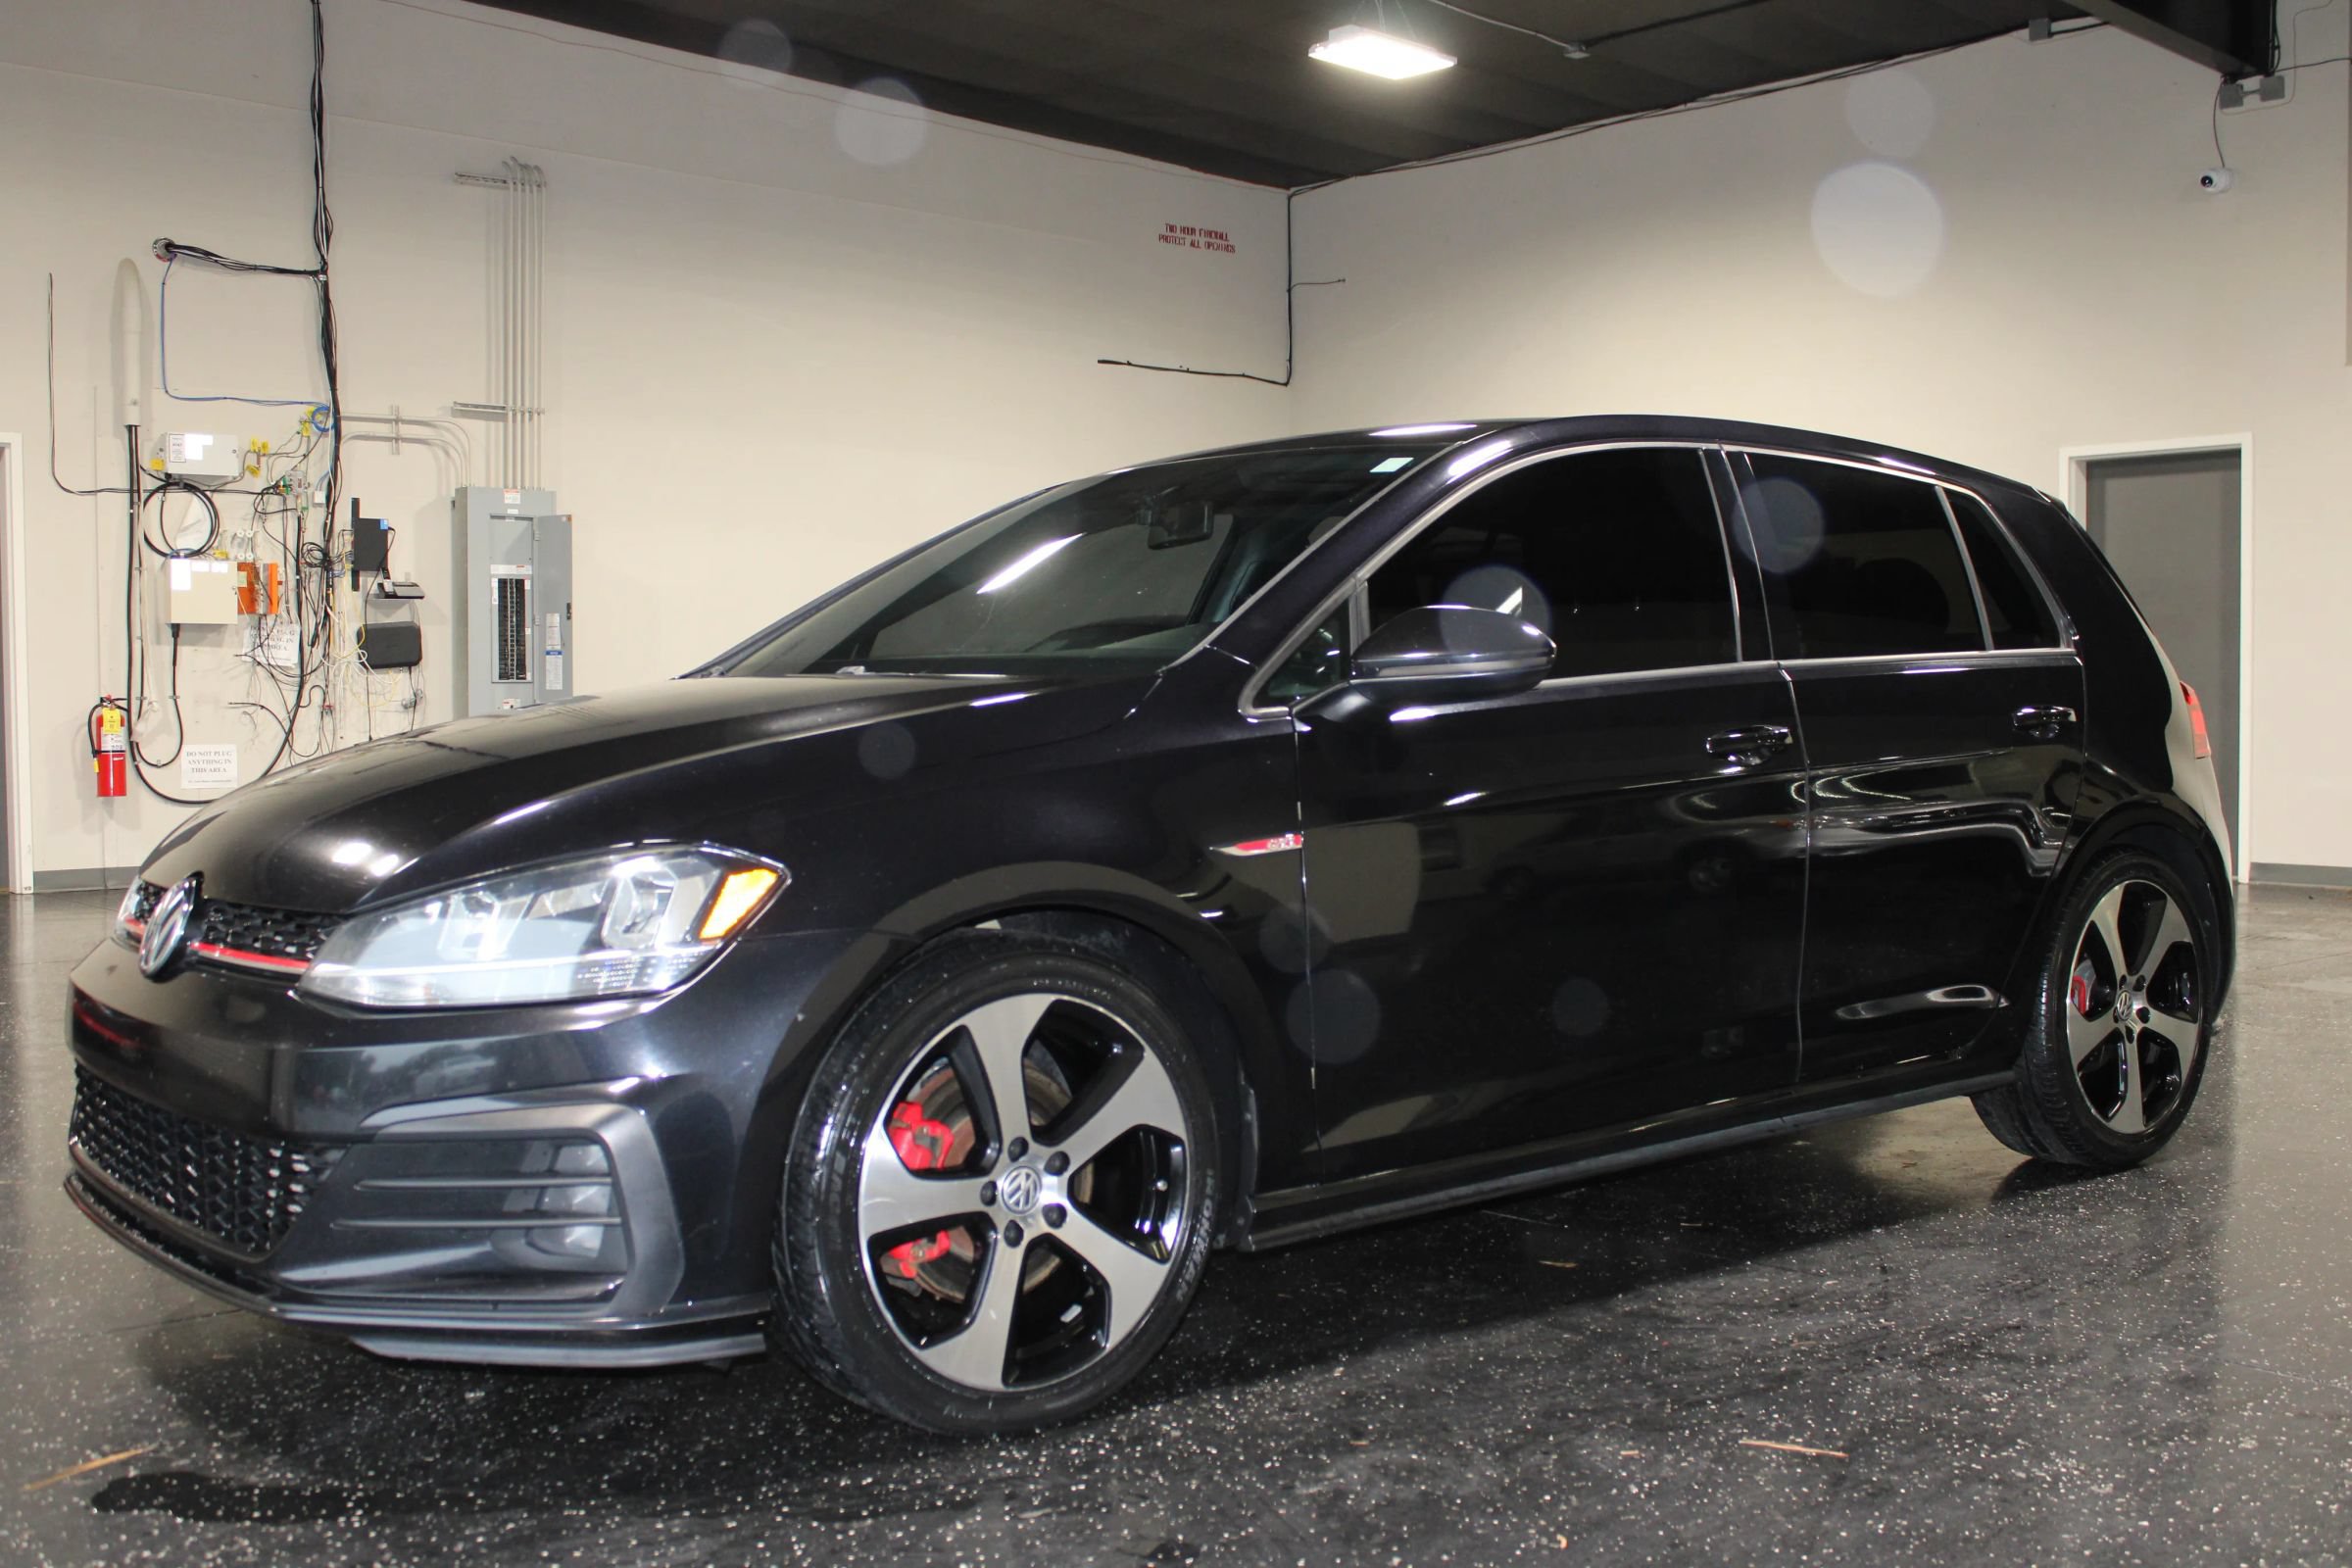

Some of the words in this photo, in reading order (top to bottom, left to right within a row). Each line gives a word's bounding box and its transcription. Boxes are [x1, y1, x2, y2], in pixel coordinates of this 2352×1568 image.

[1180, 225, 1197, 237] HOUR
[1158, 233, 1186, 246] PROTECT
[1189, 238, 1201, 250] ALL
[1204, 241, 1236, 254] OPENINGS
[1175, 1167, 1215, 1302] IRONMAN
